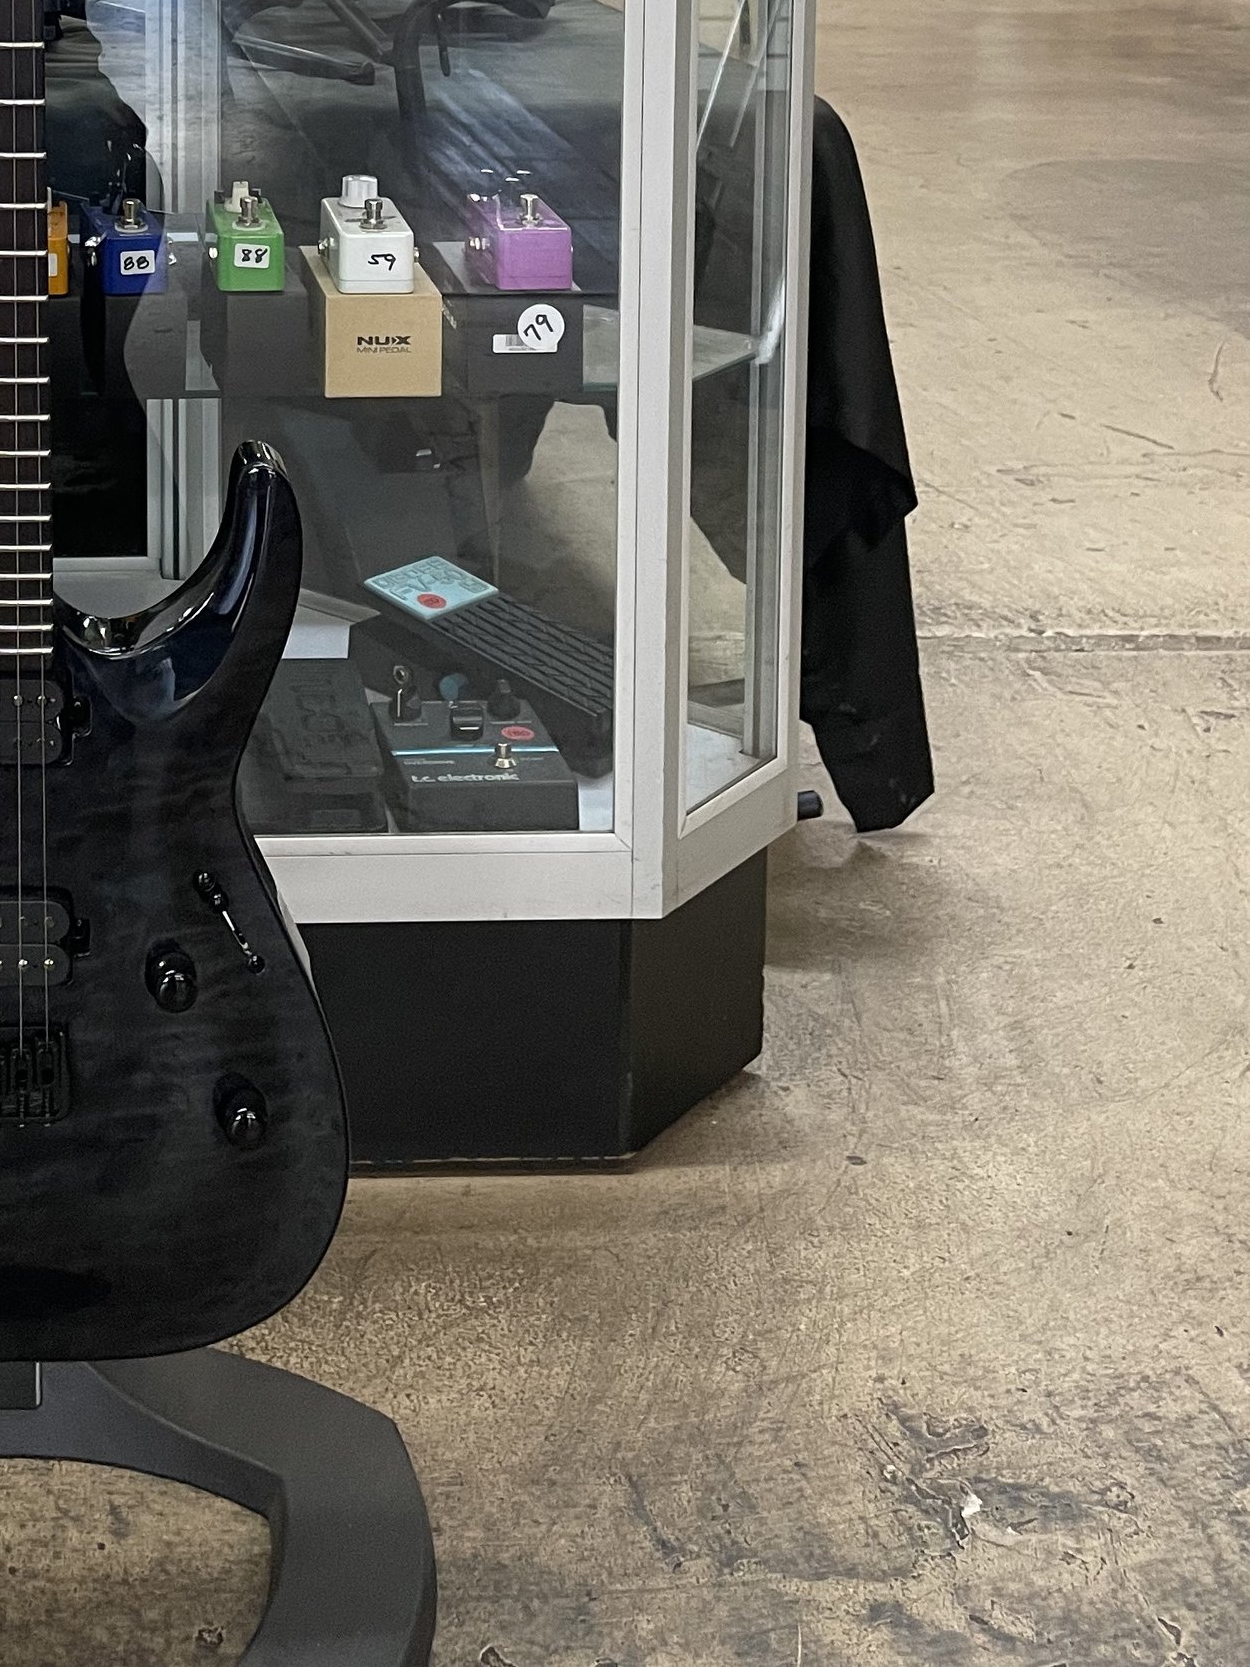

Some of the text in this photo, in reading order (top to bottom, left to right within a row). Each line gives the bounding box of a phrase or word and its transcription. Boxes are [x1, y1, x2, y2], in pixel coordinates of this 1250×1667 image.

[123, 255, 150, 271] 88
[241, 248, 269, 265] 88
[367, 253, 397, 271] 59
[523, 314, 554, 341] 79
[357, 335, 412, 346] NUX
[357, 346, 412, 354] MINI PEDAL
[437, 772, 520, 782] electronic
